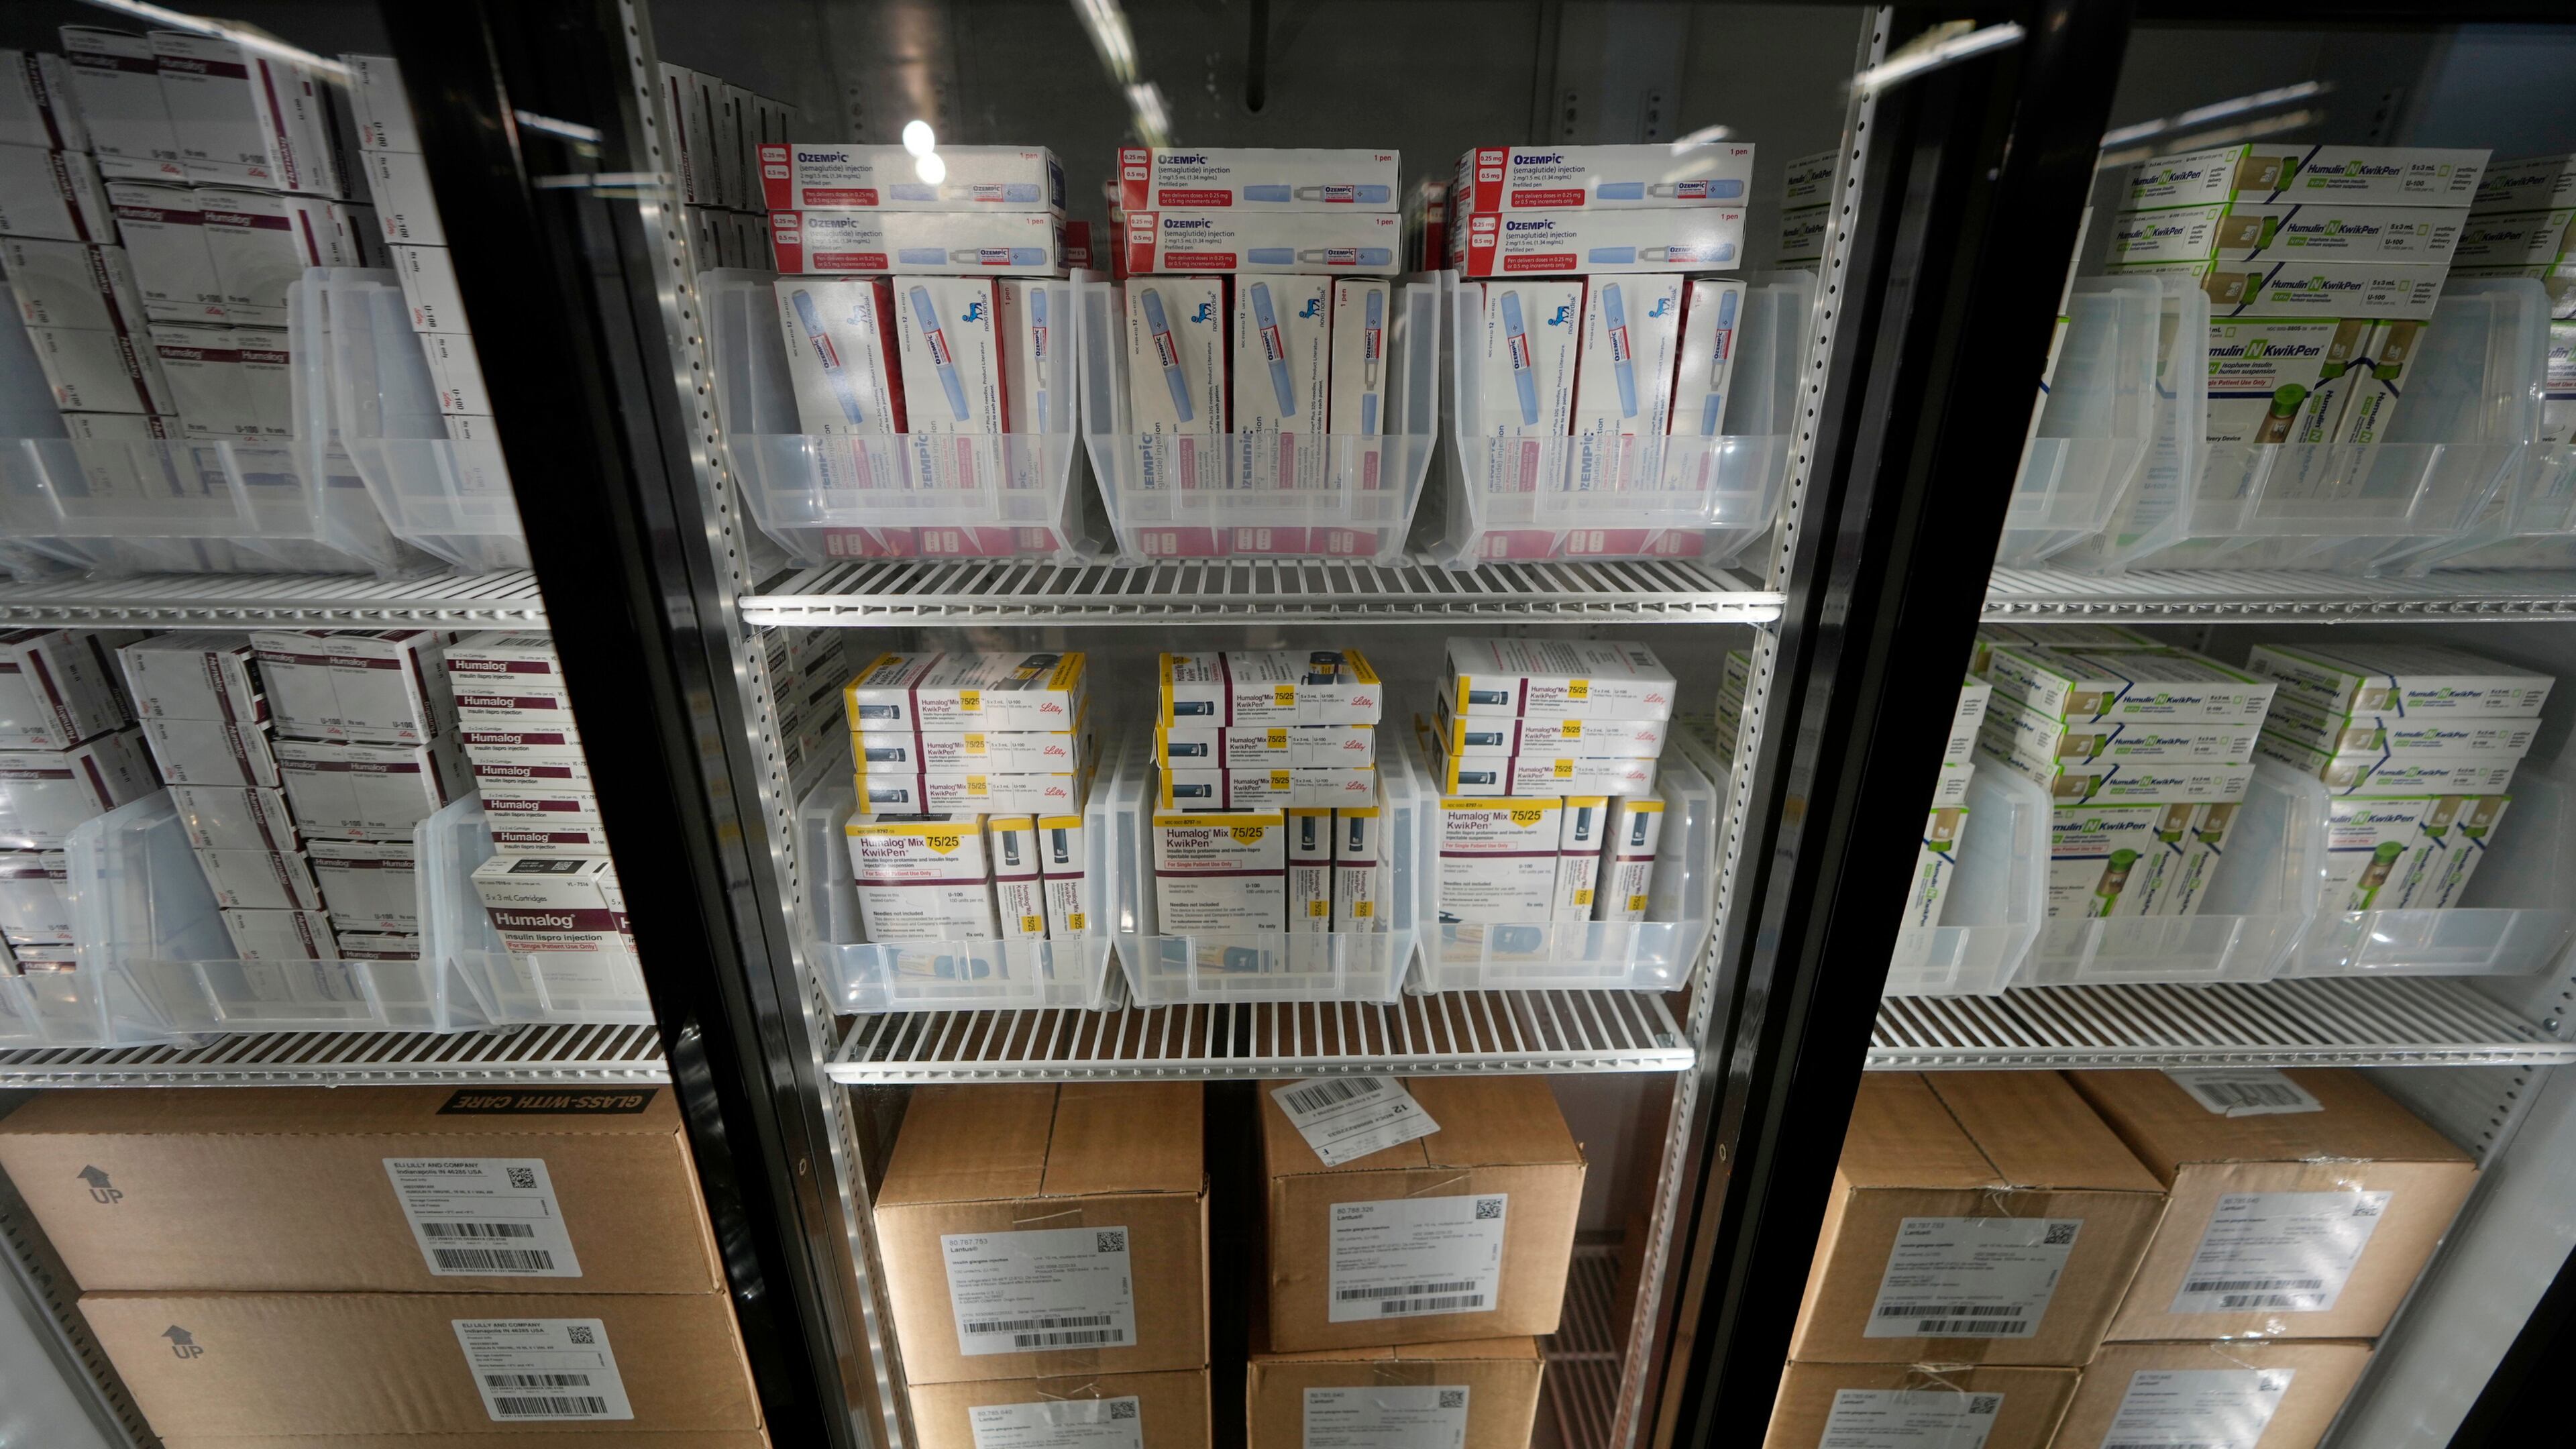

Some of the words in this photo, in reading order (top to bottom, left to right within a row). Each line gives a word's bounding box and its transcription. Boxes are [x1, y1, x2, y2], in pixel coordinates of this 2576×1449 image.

[1159, 166, 1201, 174] (semaglutide)
[1352, 696, 1373, 708] Lilly
[1644, 693, 1666, 705] Lilly
[1040, 703, 1063, 715] Lilly
[1512, 810, 1540, 820] 75/25
[1232, 827, 1263, 837] 75/25
[908, 839, 924, 847] Mix
[927, 837, 959, 847] 75/25
[453, 1096, 513, 1108] CARE
[89, 1189, 123, 1203] UP
[172, 1346, 203, 1359] UP
